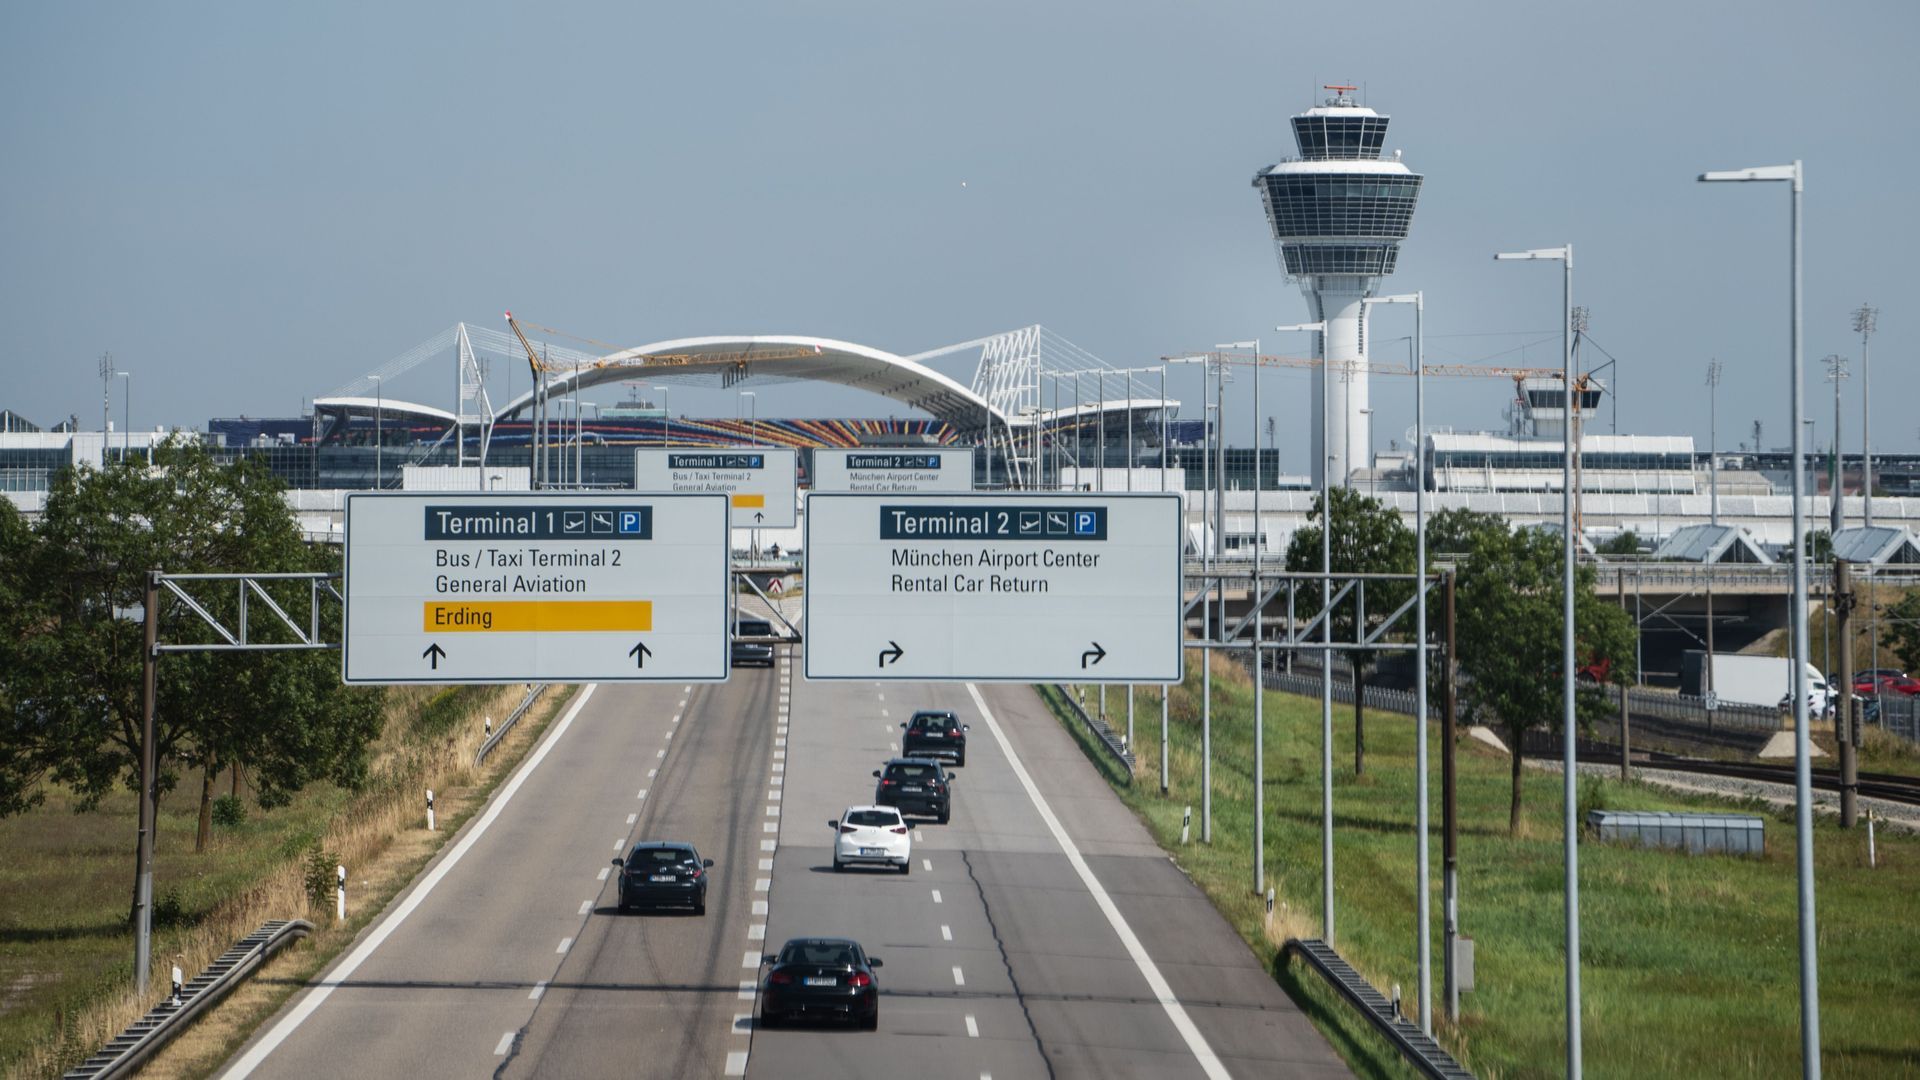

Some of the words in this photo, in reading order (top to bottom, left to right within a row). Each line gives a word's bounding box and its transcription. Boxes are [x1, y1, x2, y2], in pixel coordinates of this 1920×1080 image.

[673, 456, 716, 467] Terminal
[719, 456, 723, 467] 1
[850, 456, 892, 467] Terminal
[895, 456, 901, 467] 2
[673, 472, 688, 480] Bus
[695, 472, 710, 480] Taxi
[712, 472, 745, 480] Terminal
[746, 472, 752, 480] 2
[850, 472, 885, 480] München
[887, 472, 913, 483] Airport
[914, 472, 939, 480] Center
[673, 483, 704, 491] General
[705, 483, 737, 491] Aviation
[850, 483, 875, 491] Rental
[876, 483, 890, 491] Car
[892, 483, 918, 491] Return
[437, 512, 536, 534] Terminal
[546, 512, 554, 534] 1
[892, 512, 989, 534] Terminal
[997, 512, 1009, 534] 2
[436, 549, 470, 567] Bus
[474, 549, 482, 568] /
[487, 549, 523, 567] Taxi
[528, 549, 606, 567] Terminal
[611, 549, 622, 567] 2
[892, 549, 973, 567] München
[978, 549, 1039, 570] Airport
[1043, 549, 1100, 567] Center
[436, 575, 507, 593] General
[513, 575, 586, 593] Aviation
[892, 575, 947, 592] Rental
[954, 575, 984, 592] Car
[990, 575, 1049, 593] Return
[435, 607, 493, 629] Erding
